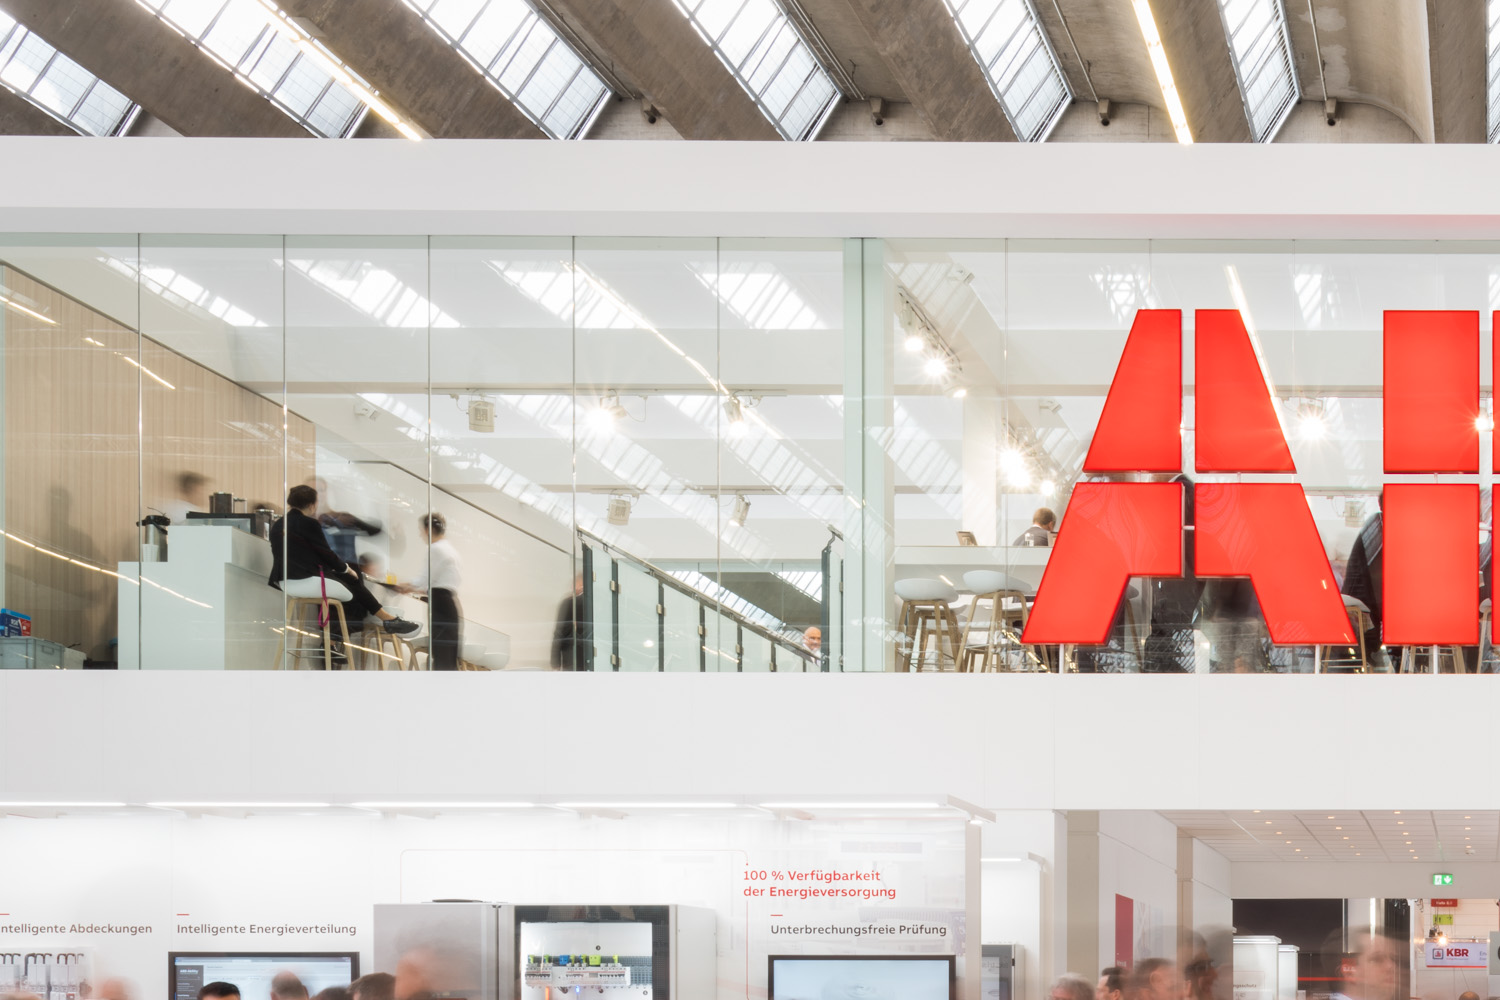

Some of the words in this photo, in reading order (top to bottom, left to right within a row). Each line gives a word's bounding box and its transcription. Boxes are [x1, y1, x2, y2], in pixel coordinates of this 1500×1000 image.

[743, 870, 767, 881] 100
[772, 870, 784, 881] %
[788, 870, 880, 883] Verfügbarkeit
[743, 886, 765, 897] der
[770, 886, 896, 899] Energieversorgung
[1, 923, 66, 936] ntelligente
[69, 923, 152, 936] Abdeckungen
[177, 923, 246, 936] Intelligente
[250, 923, 357, 936] Energieverteilung
[771, 924, 896, 936] Unterbrechungsfreie
[899, 924, 947, 936] Prüfung
[1446, 948, 1469, 957] KBR
